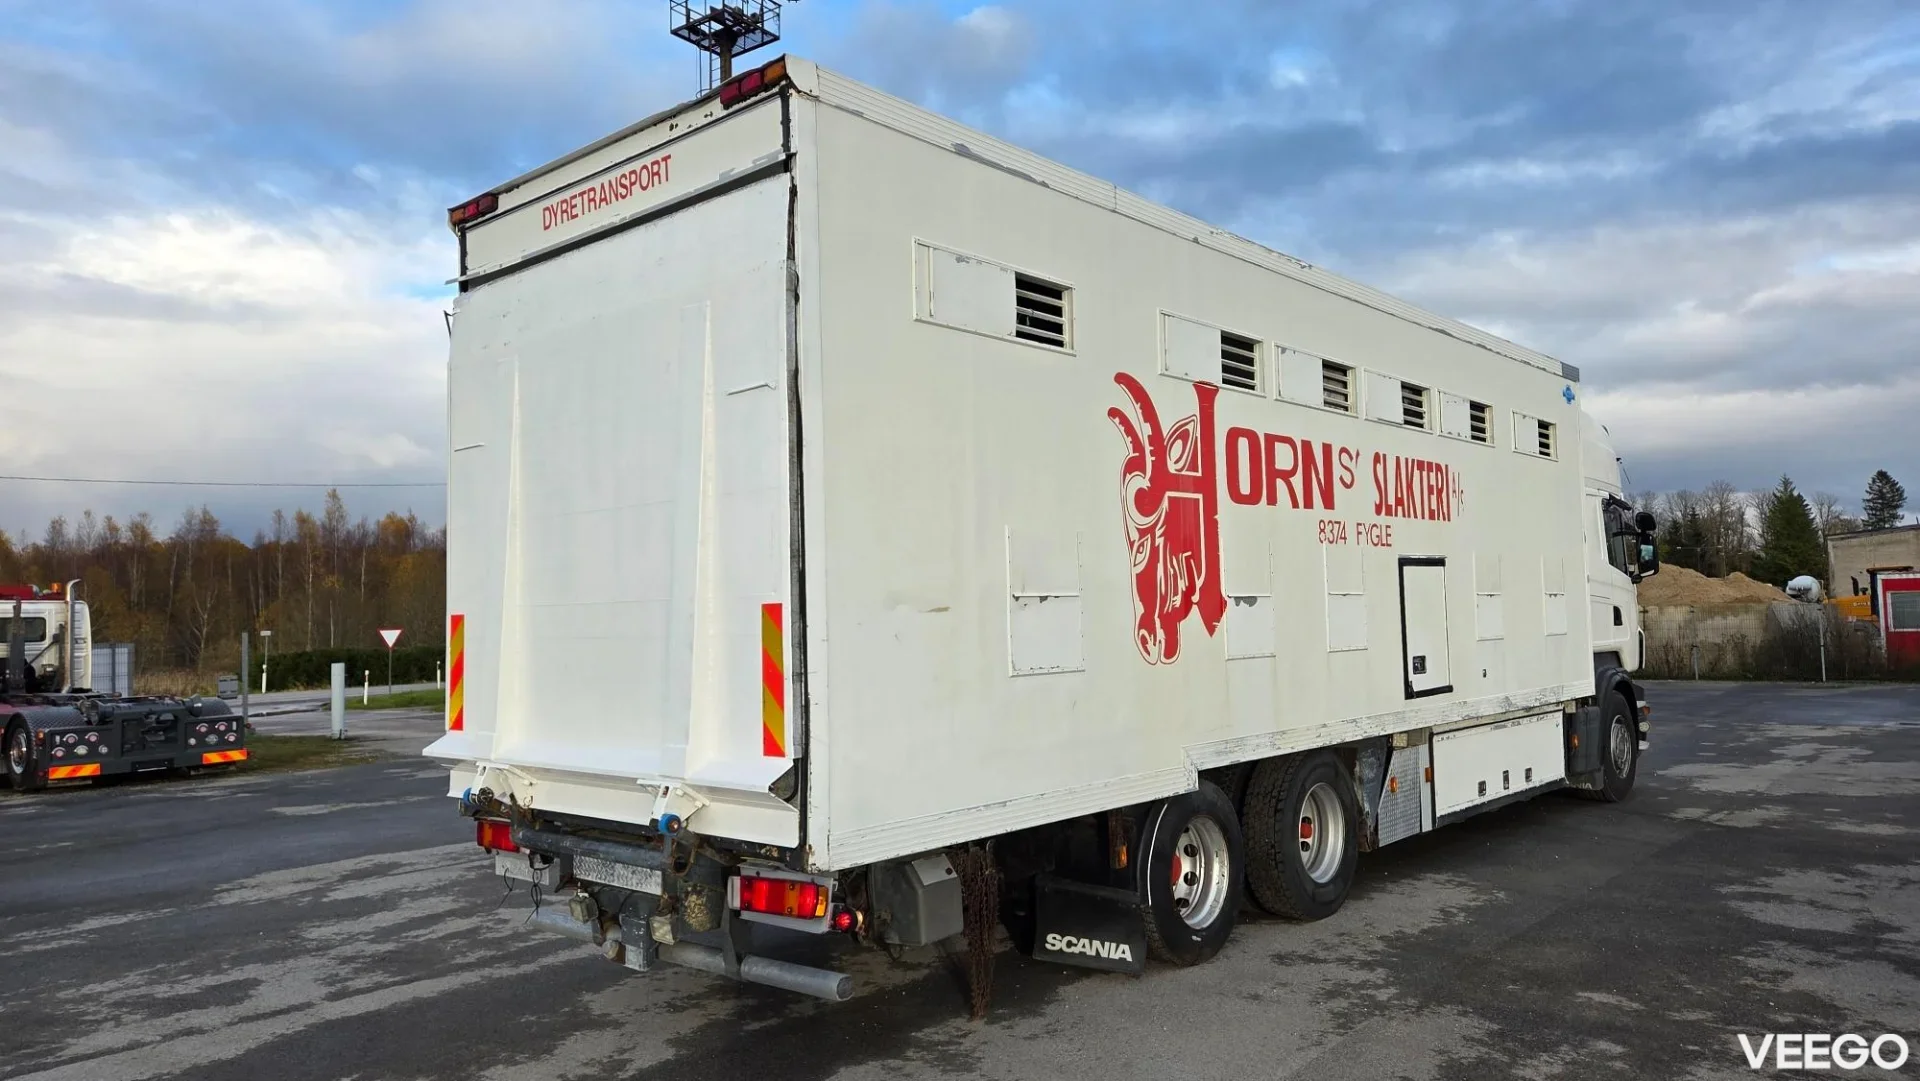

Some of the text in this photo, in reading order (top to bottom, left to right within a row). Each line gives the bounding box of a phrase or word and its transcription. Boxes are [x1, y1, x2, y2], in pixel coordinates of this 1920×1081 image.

[542, 154, 672, 231] DYRETRANSPORT
[1372, 451, 1452, 522] SLAKTERI
[1318, 519, 1392, 548] 8374 FYGLE
[1044, 933, 1133, 962] SCANIA
